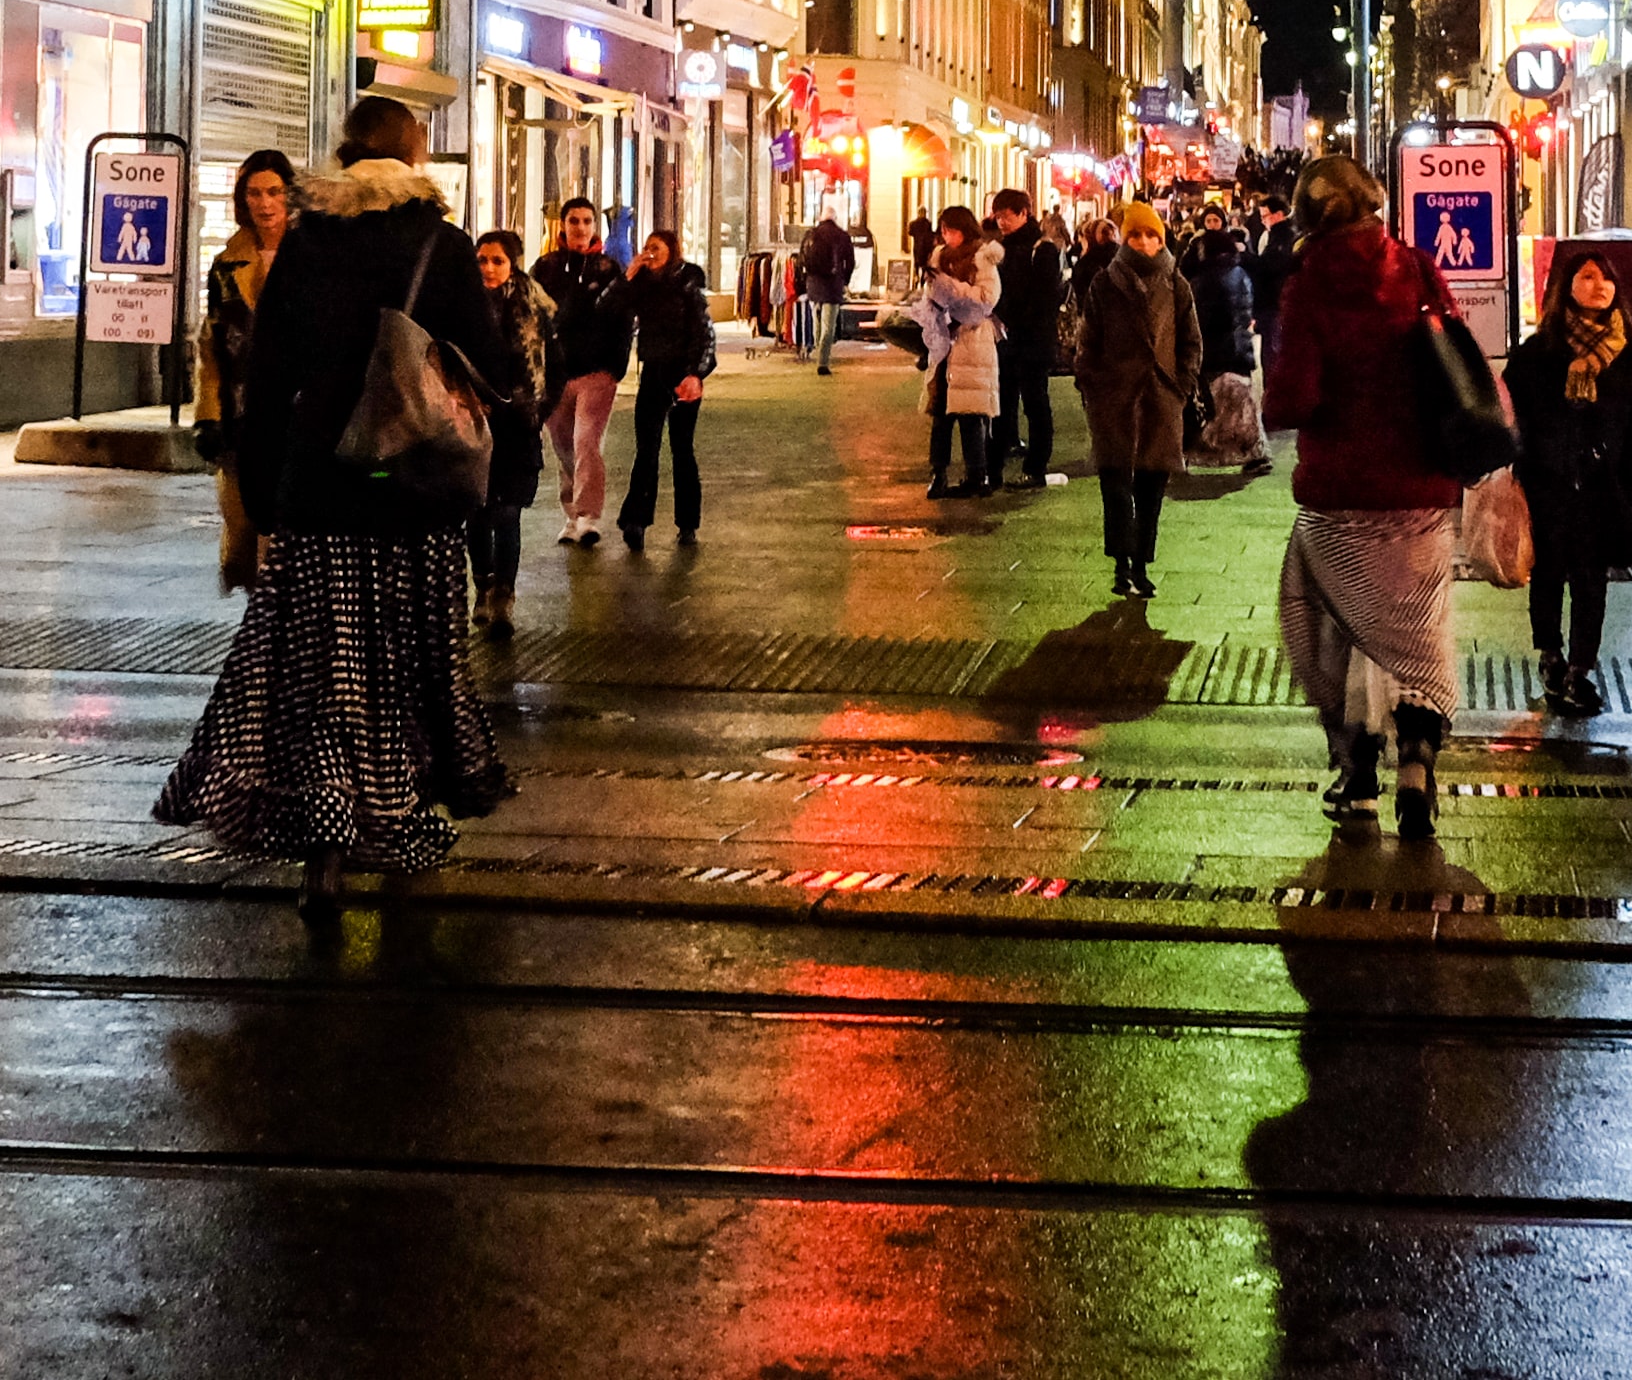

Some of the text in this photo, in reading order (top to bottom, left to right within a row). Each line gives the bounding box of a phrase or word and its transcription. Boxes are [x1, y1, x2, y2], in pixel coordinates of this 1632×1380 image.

[1516, 50, 1554, 91] N
[109, 160, 166, 183] Sone
[1419, 153, 1486, 177] Sone
[113, 195, 158, 212] Gågate
[1426, 194, 1479, 210] Gågate
[94, 284, 168, 296] Varetransport
